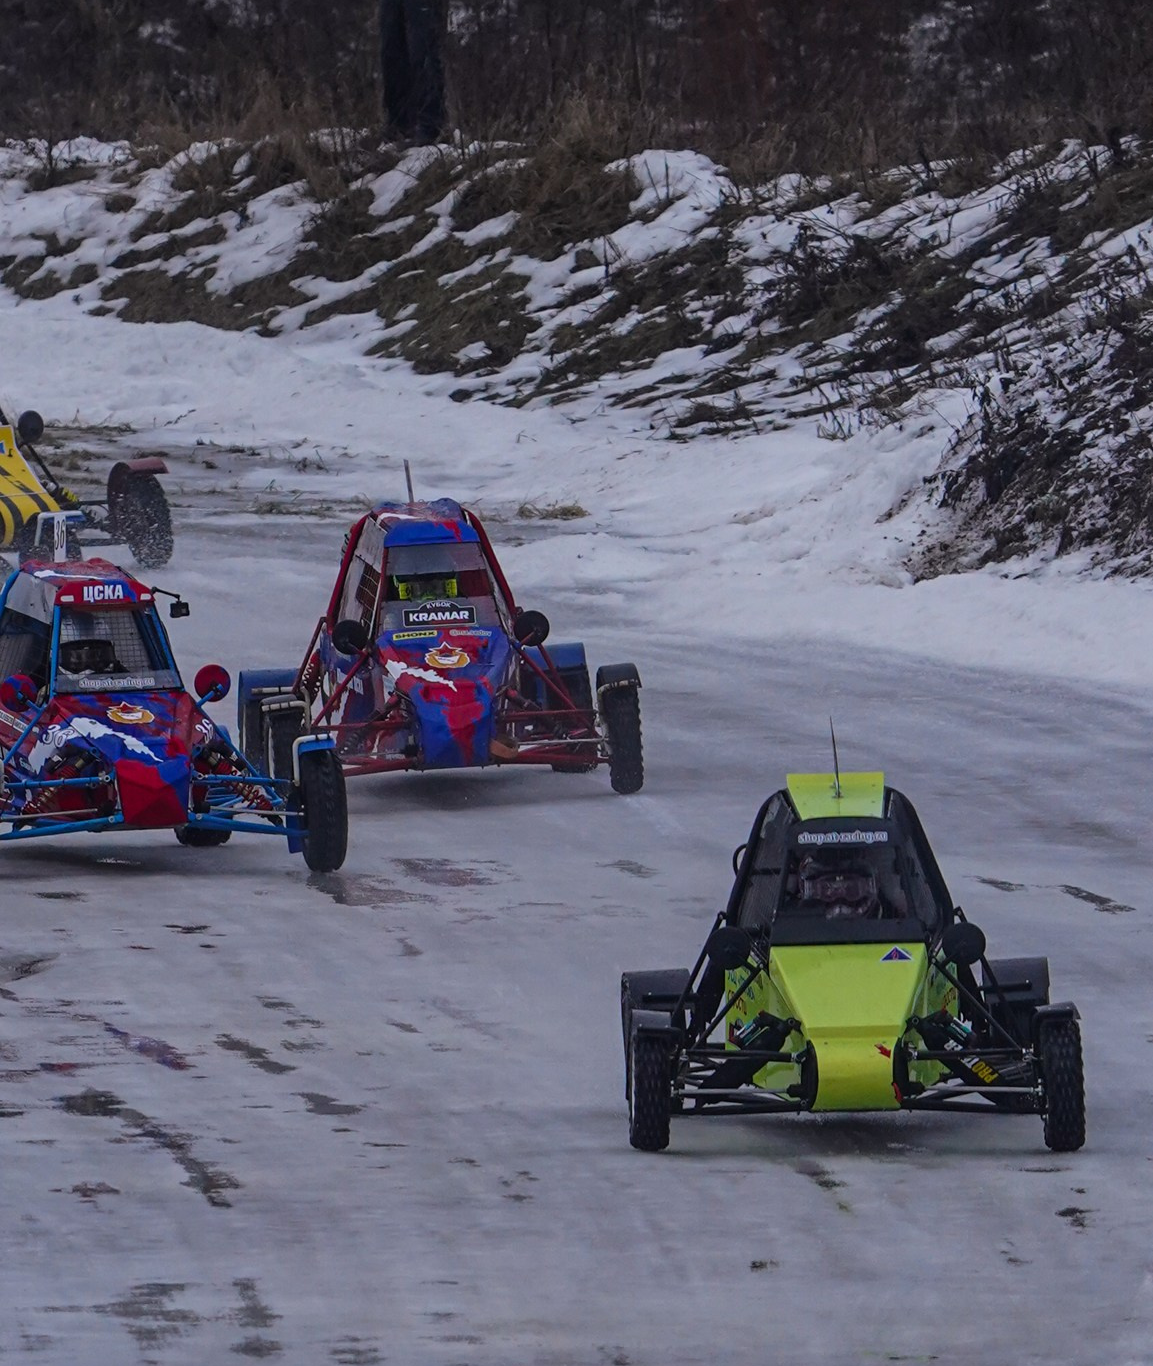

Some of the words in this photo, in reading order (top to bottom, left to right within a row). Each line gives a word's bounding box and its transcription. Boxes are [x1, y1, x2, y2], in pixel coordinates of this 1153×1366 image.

[55, 519, 65, 551] 36
[83, 584, 124, 603] ЦСКА
[409, 610, 470, 622] KRAMAR
[42, 724, 74, 748] 36
